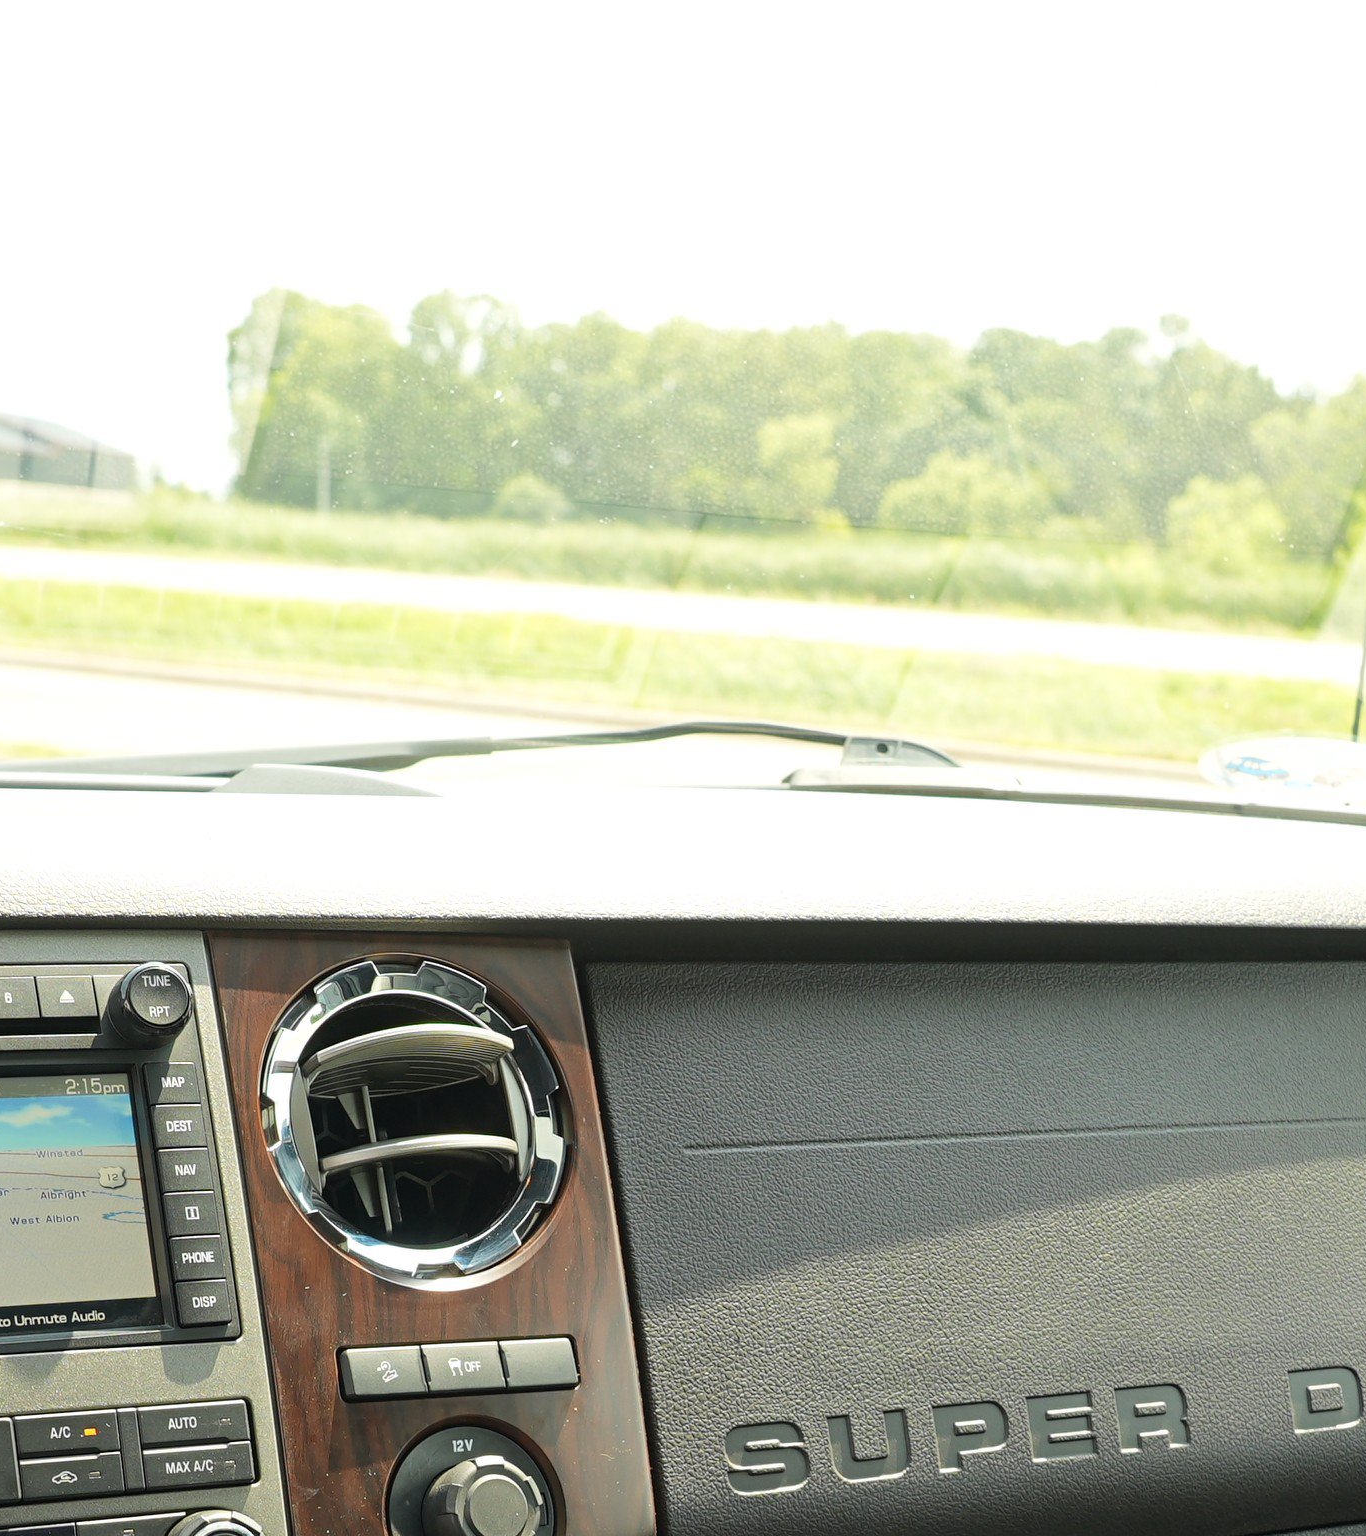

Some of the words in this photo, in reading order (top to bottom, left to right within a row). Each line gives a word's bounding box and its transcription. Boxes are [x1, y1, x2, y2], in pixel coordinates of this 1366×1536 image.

[141, 975, 171, 987] TUNE
[4, 992, 13, 1004] 6
[148, 1006, 170, 1019] RPT
[66, 1078, 126, 1096] 2:15pm
[161, 1076, 185, 1089] MAP
[166, 1120, 192, 1132] DEST
[35, 1148, 83, 1159] Winsted
[174, 1164, 196, 1176] NAV
[107, 1173, 119, 1182] 12
[40, 1189, 87, 1201] Albright
[9, 1216, 40, 1226] West
[46, 1214, 80, 1224] Albion
[182, 1251, 215, 1264] PHONE
[192, 1296, 217, 1309] DISP
[14, 1313, 67, 1325] Unmute
[71, 1310, 106, 1322] Audio
[464, 1360, 481, 1373] OFF
[168, 1416, 197, 1430] AUTO
[50, 1426, 71, 1439] A/C
[724, 1381, 1194, 1498] SUPER
[165, 1461, 190, 1474] MAX
[193, 1459, 214, 1473] A/C
